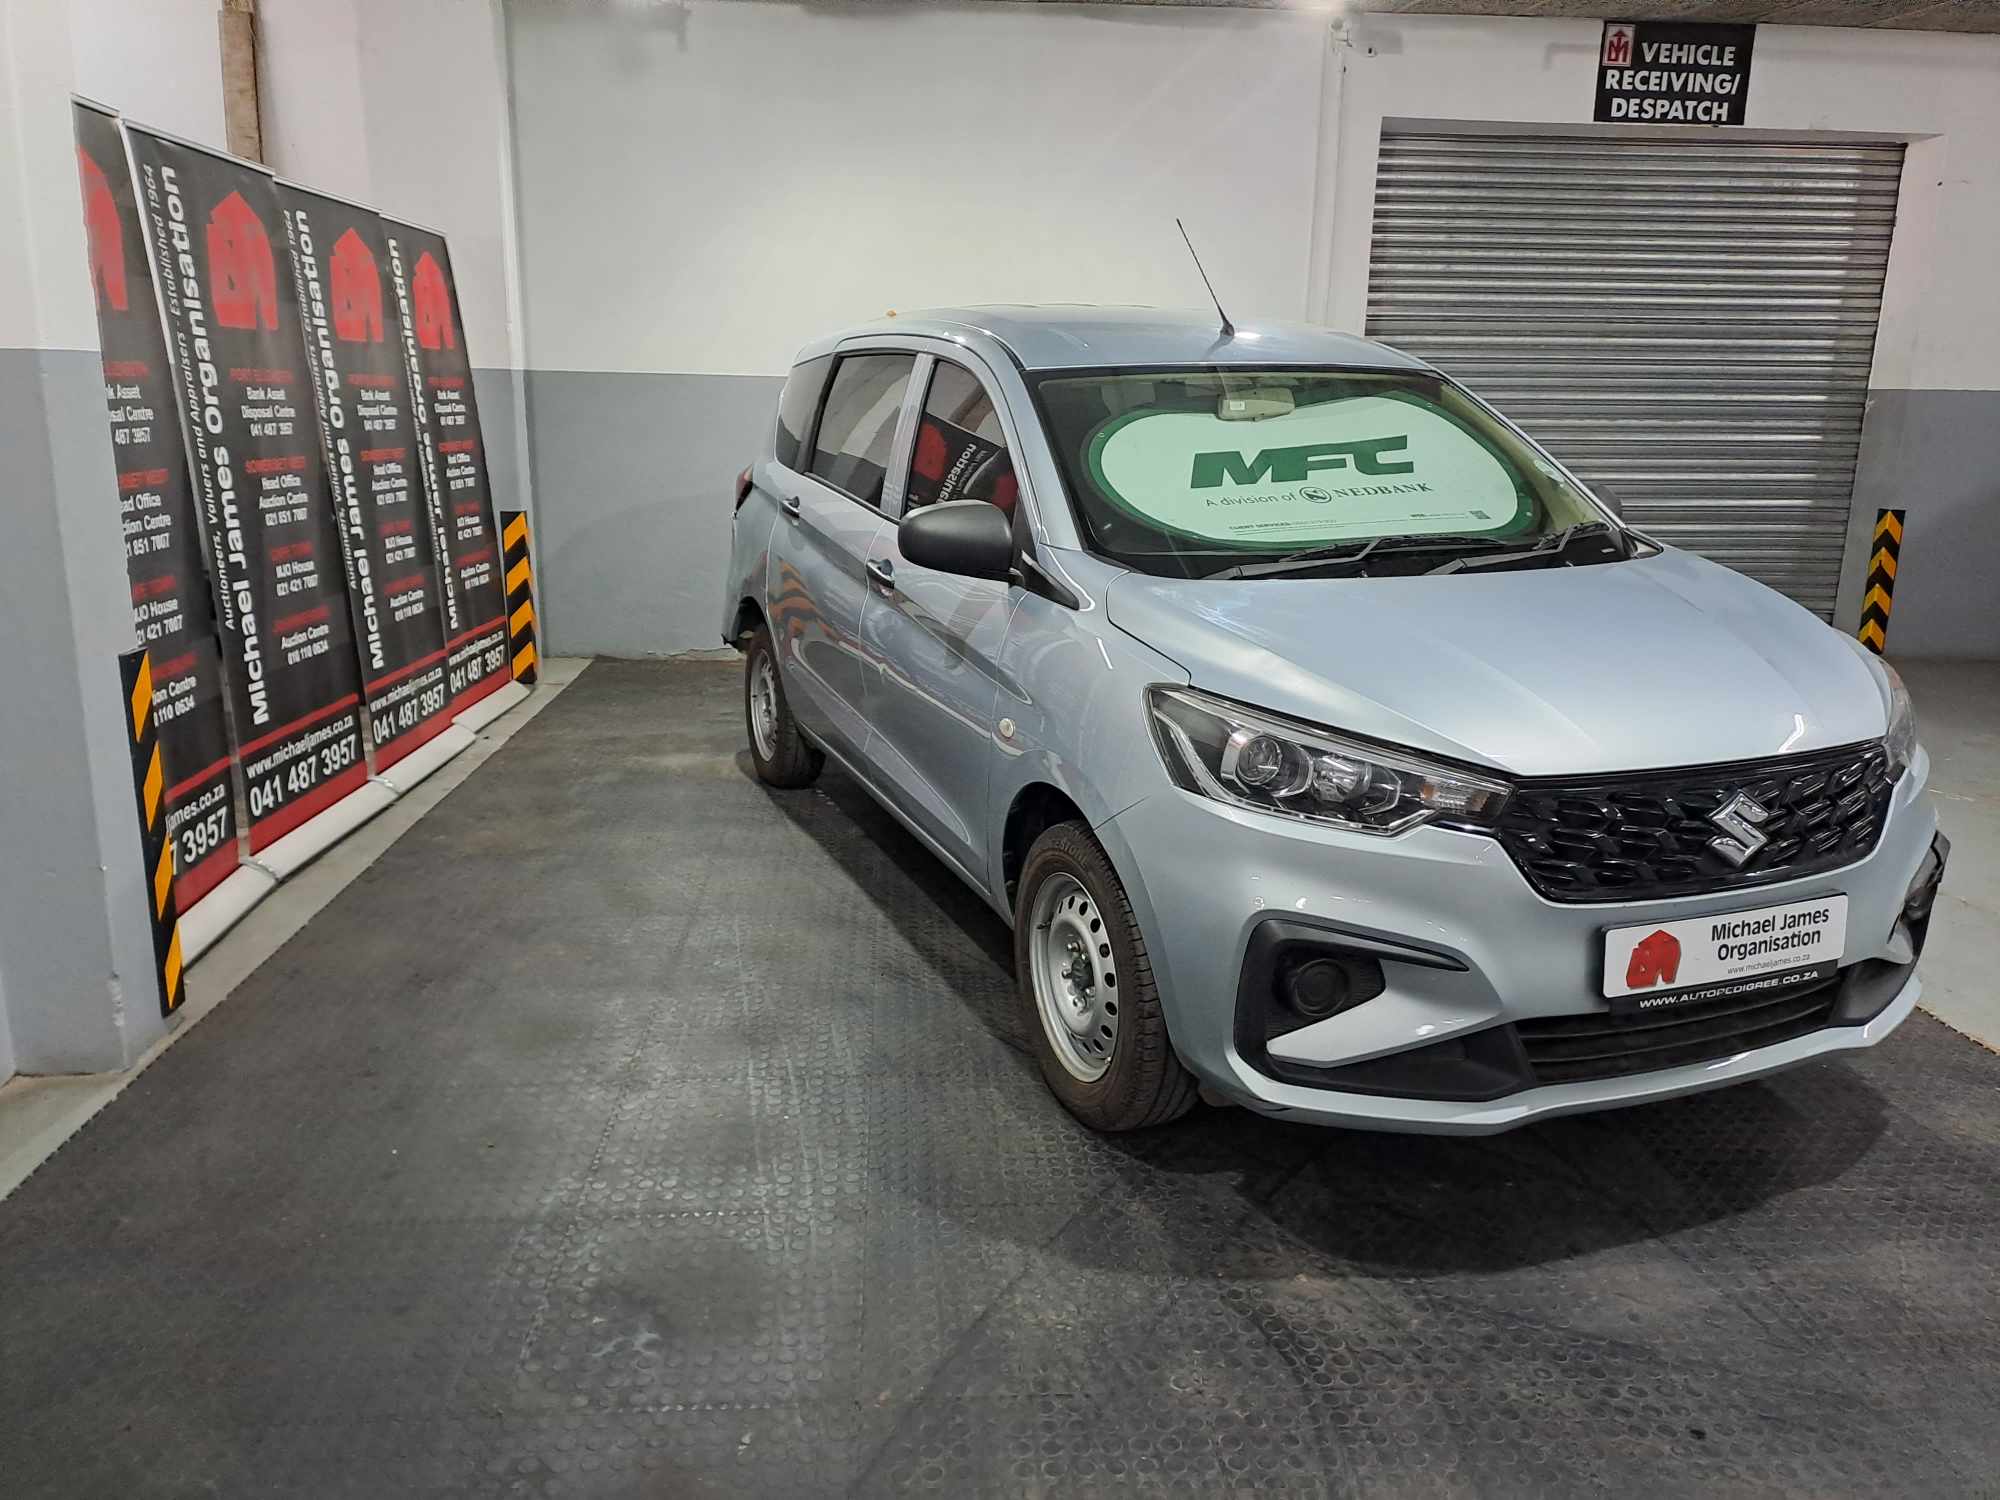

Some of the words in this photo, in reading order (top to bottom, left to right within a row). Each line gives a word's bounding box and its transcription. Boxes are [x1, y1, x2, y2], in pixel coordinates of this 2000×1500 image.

[1605, 69, 1741, 95] RECEIVING/
[1641, 42, 1736, 66] VEHICLE
[1610, 97, 1729, 122] DESPATCH
[143, 164, 161, 209] 1964
[151, 214, 181, 316] Established
[161, 165, 223, 435] Organisation
[295, 210, 345, 429] Organisation
[387, 238, 427, 424] Organisation
[178, 332, 201, 420] Appraisers
[191, 427, 208, 459] and
[1191, 435, 1414, 488] MFC
[200, 464, 217, 524] Valuers
[213, 445, 247, 571] James
[337, 438, 365, 540] James
[423, 432, 443, 520] James
[1205, 498, 1218, 507] A
[1220, 493, 1278, 506] division
[1281, 491, 1297, 502] of
[1334, 482, 1434, 500] NEDBANK
[213, 531, 235, 630] Auctioneers,
[353, 549, 384, 669] Michael
[437, 527, 458, 630] Michael
[232, 579, 270, 726] Michael
[450, 667, 467, 694] 041
[467, 656, 482, 682] 487
[485, 645, 505, 673] 3957
[372, 711, 397, 745] 041
[398, 698, 418, 729] 487
[420, 683, 445, 716] 3957
[246, 715, 355, 779] www.michaeljames.co.za
[249, 774, 283, 817] 041
[287, 755, 317, 793] 487
[320, 733, 356, 776] 3957
[182, 805, 228, 863] 3957
[1711, 915, 1777, 942] Michael
[1779, 908, 1830, 931] James
[1717, 928, 1821, 961] Organisation
